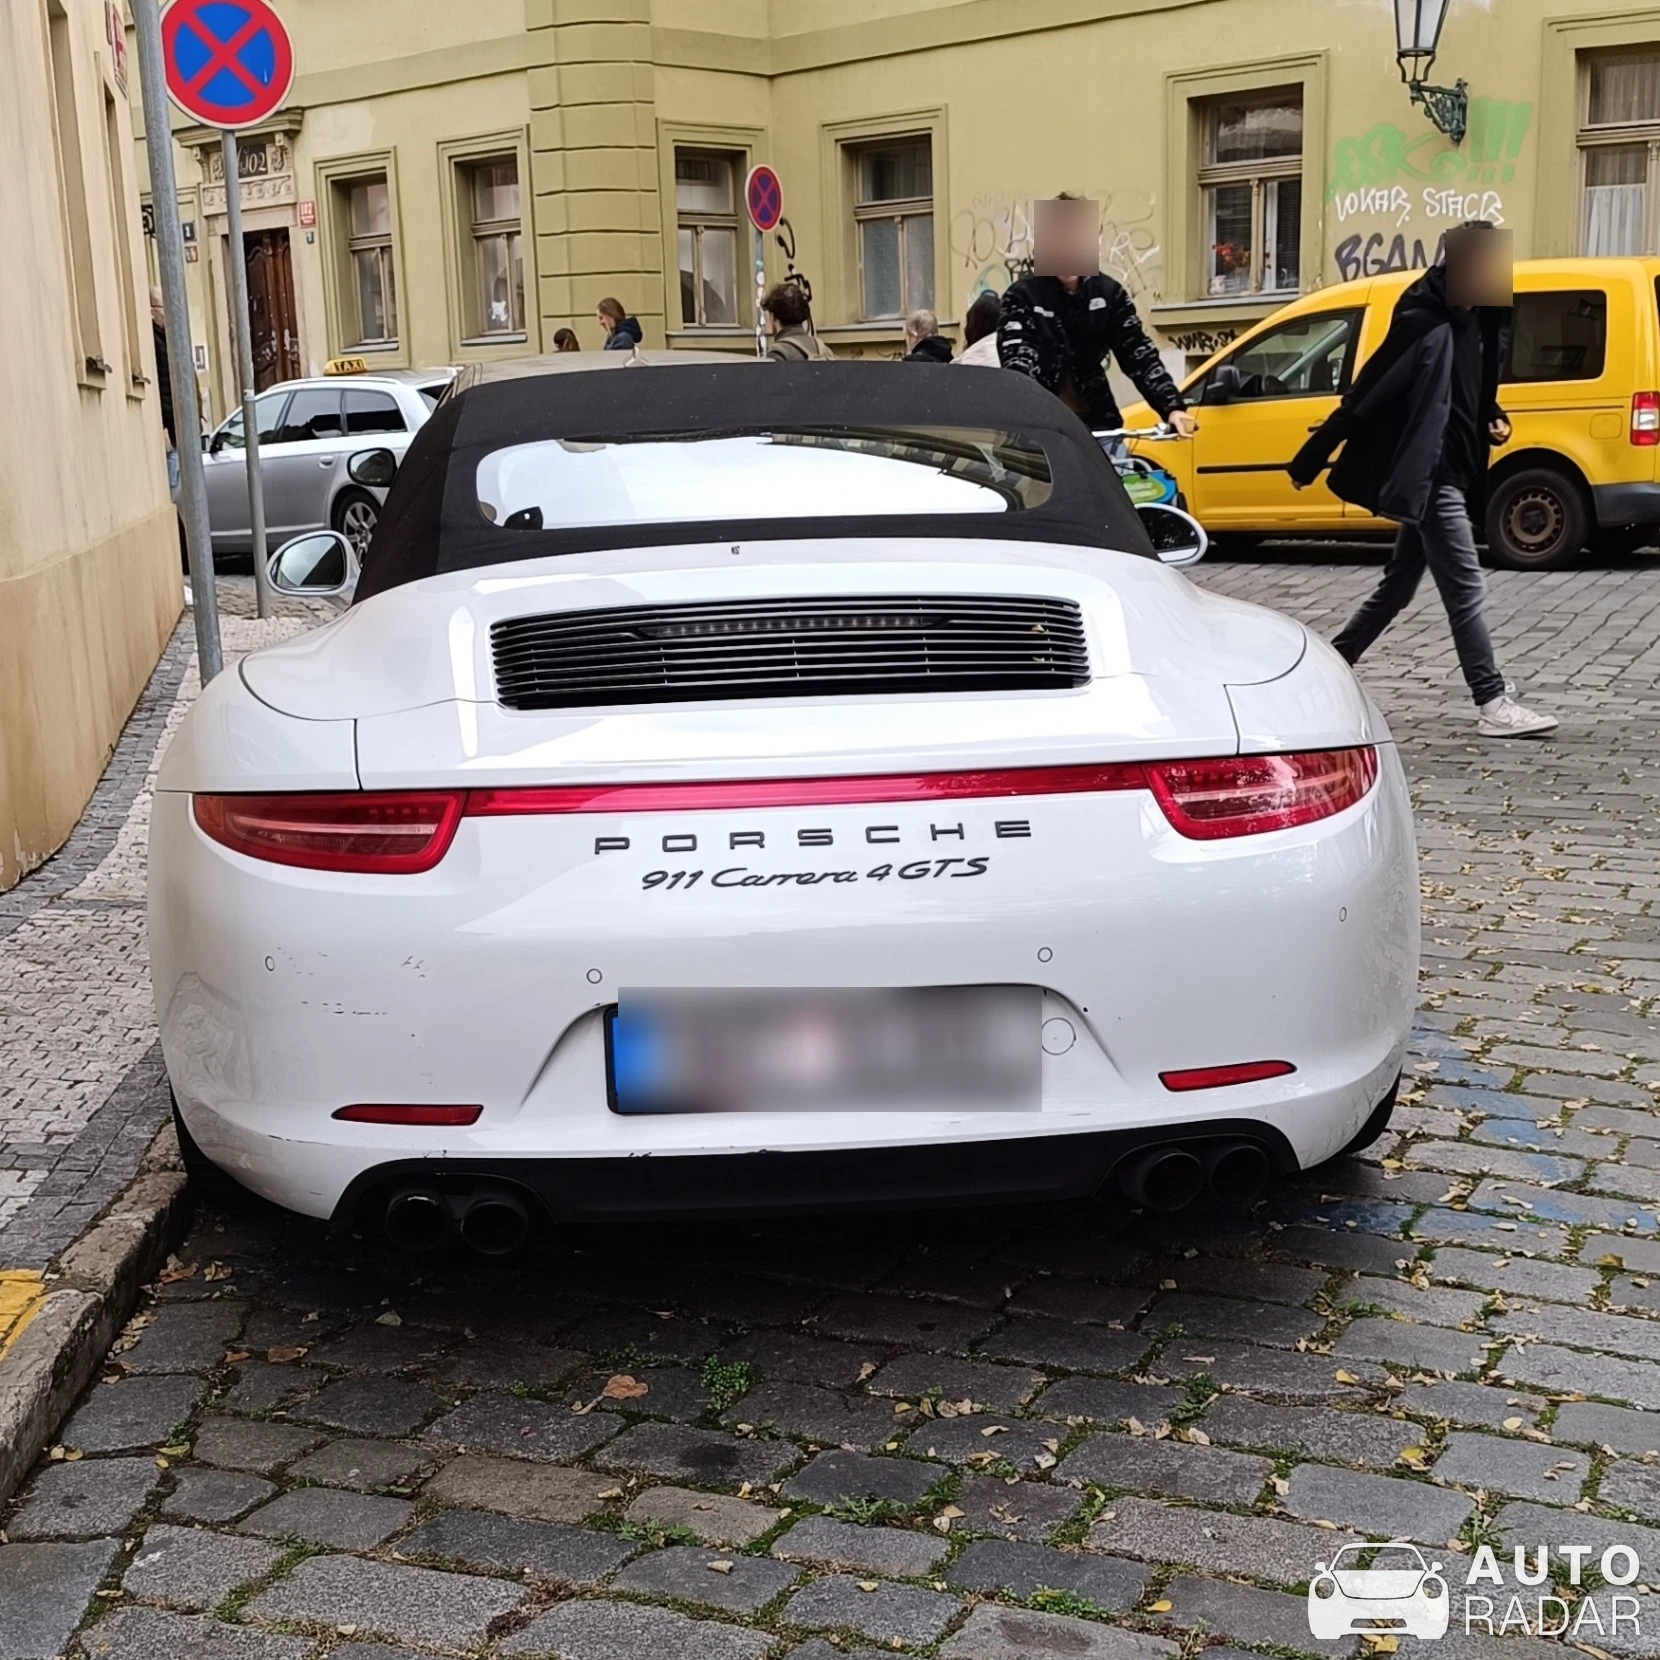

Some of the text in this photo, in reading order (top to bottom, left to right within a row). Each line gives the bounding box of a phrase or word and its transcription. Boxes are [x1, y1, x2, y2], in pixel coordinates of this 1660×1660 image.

[334, 359, 365, 373] TAXI
[594, 820, 1032, 855] PORSCHE
[641, 857, 990, 891] 911 Carrera 4 GTS
